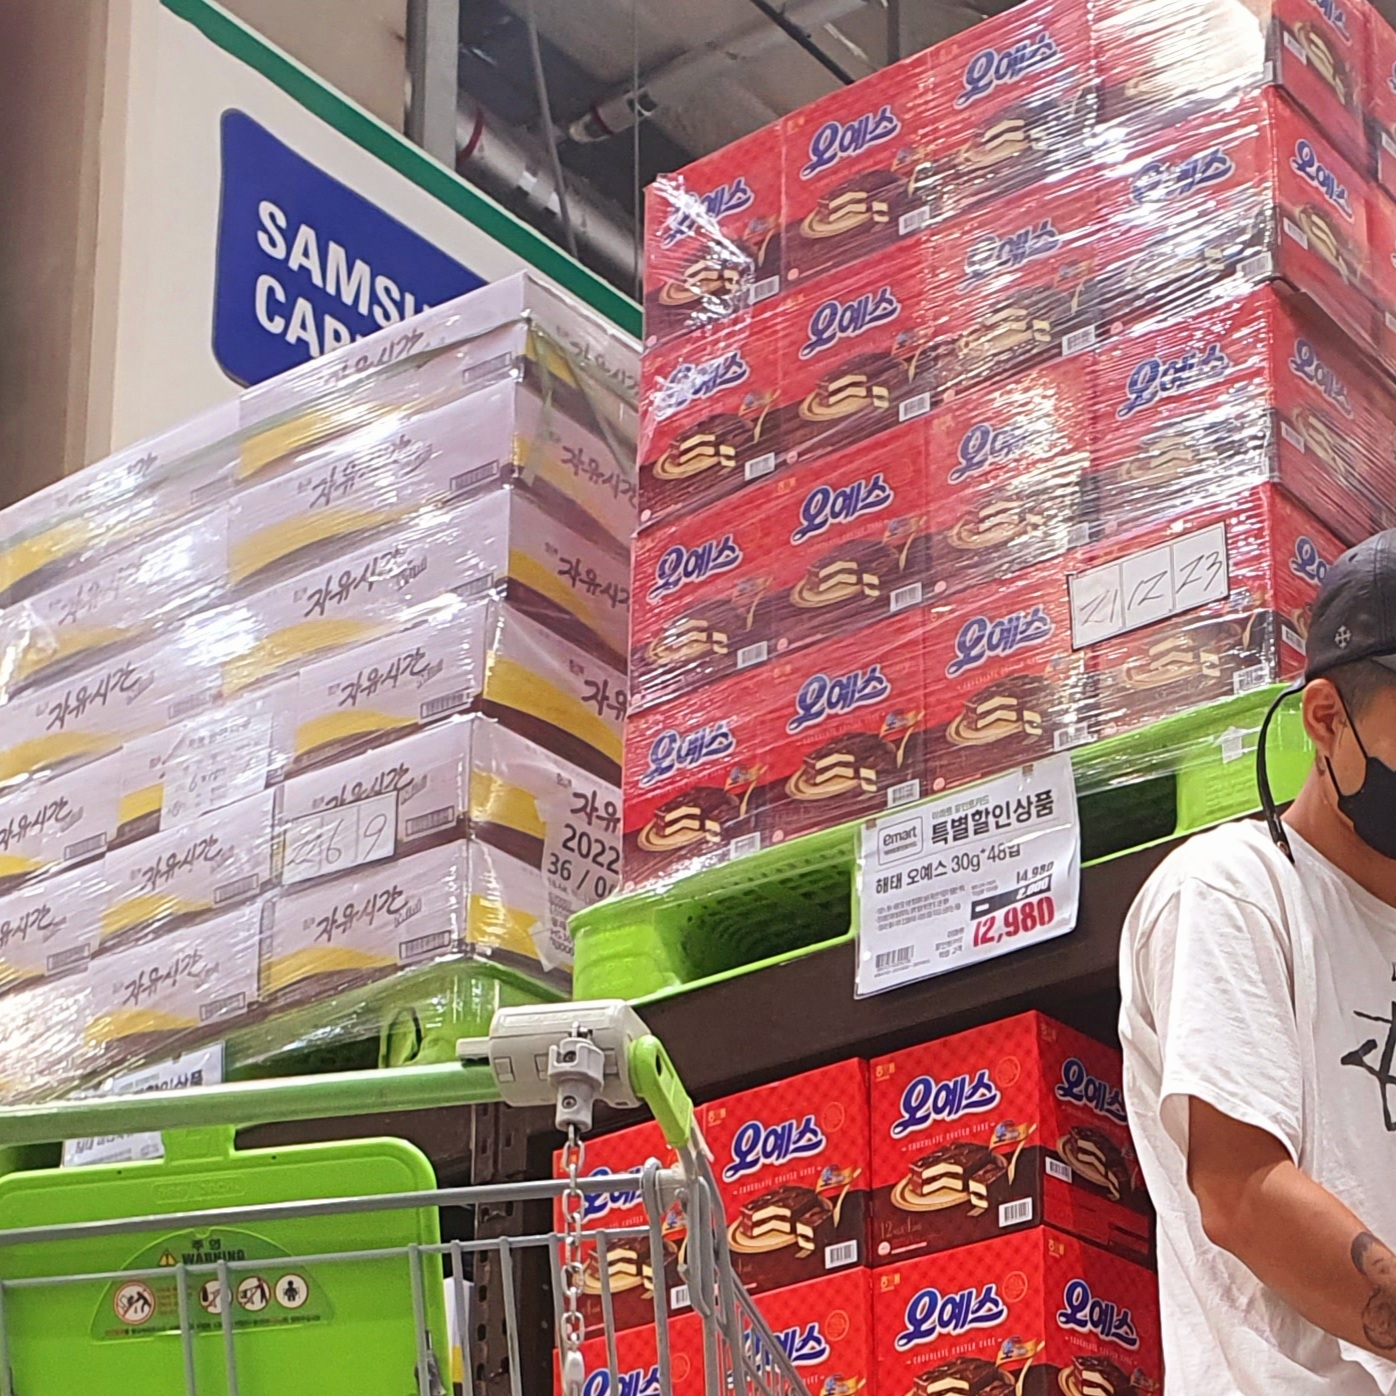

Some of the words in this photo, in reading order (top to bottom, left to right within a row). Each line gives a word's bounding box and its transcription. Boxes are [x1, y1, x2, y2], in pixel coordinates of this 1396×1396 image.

[954, 32, 1059, 110] 오예스
[800, 106, 901, 180] 오예스
[1290, 139, 1355, 223] 오예스
[256, 200, 432, 328] SAMSU
[956, 218, 1062, 293] 오예스
[255, 274, 362, 358] CAR
[800, 287, 900, 358] 오예스
[1116, 344, 1232, 418] 오예스
[1290, 337, 1355, 420] 오예스
[791, 471, 895, 544] 오예스
[646, 533, 743, 603] 오예스
[945, 602, 1055, 678] 오예스
[48, 659, 141, 729] 자유시간
[339, 647, 426, 706] 자유시간
[786, 665, 890, 734] 오예스
[639, 718, 737, 789] 오예스
[364, 814, 387, 860] 9
[562, 823, 621, 875] 2022
[883, 825, 917, 846] emart
[931, 789, 1055, 845] 특별할인상품
[139, 834, 223, 891] 자유시간
[876, 870, 902, 895] 해태
[906, 860, 948, 886] 오예스
[314, 885, 409, 942] 자유시간
[972, 895, 1056, 948] 12,980
[123, 949, 206, 1006] 자유시간
[891, 1069, 1001, 1138] 오예스
[724, 1116, 826, 1181] 오예스
[896, 1283, 1008, 1351] 오예스
[1056, 1280, 1140, 1351] 오예스
